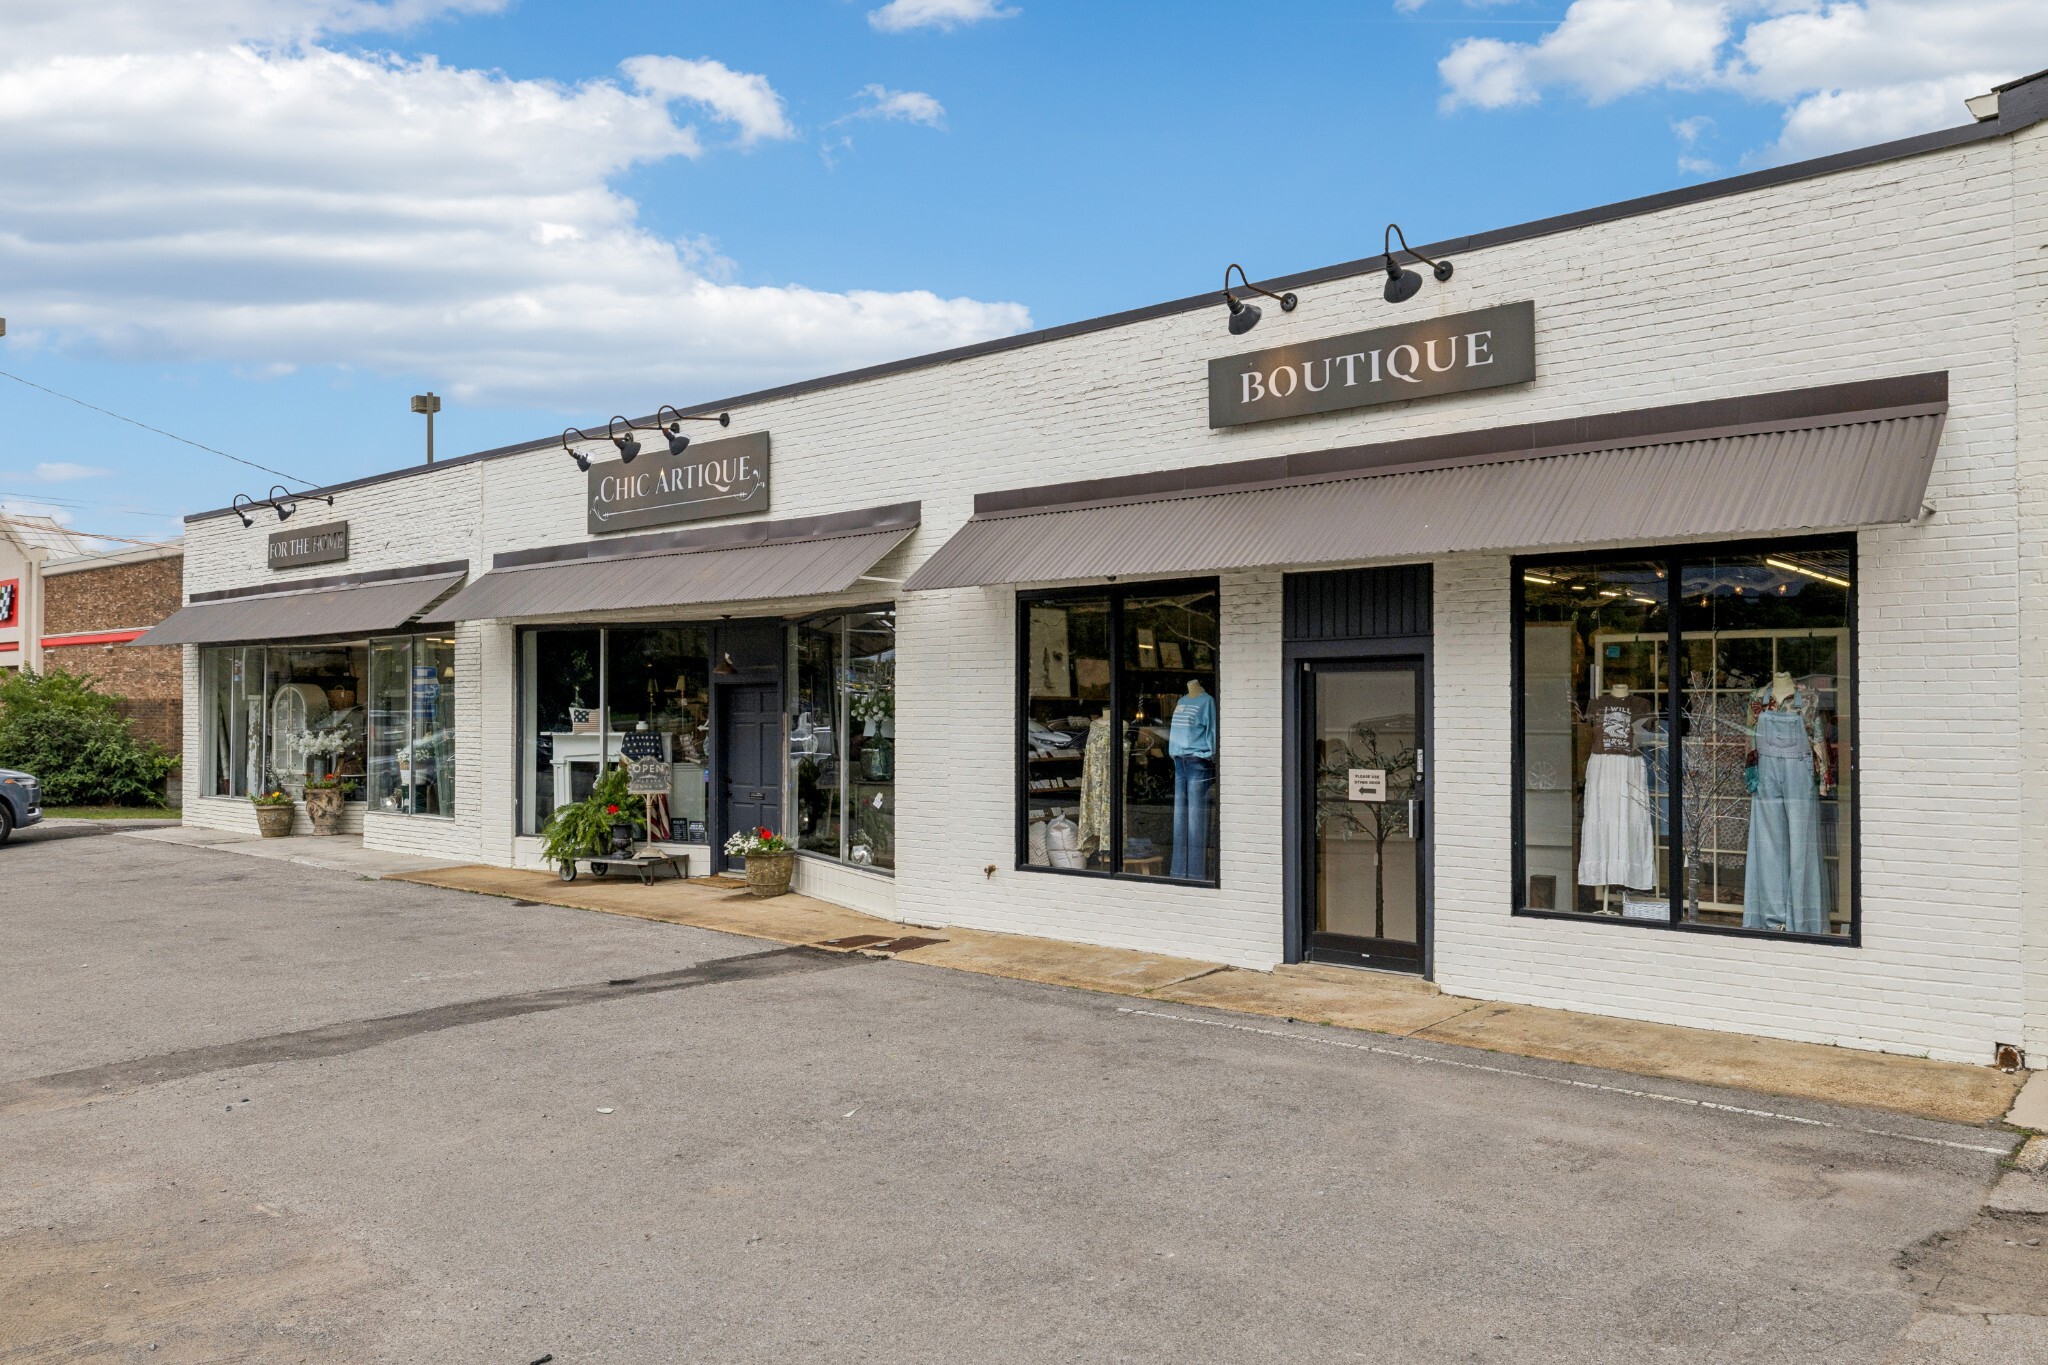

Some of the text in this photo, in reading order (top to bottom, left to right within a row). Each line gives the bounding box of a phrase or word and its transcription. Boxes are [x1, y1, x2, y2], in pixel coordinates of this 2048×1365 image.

[1239, 330, 1494, 404] BOUTIQUE
[601, 456, 750, 502] CHIC ARTIQUE
[269, 531, 344, 559] FOR THE HOME
[1610, 706, 1632, 715] WILL
[632, 764, 664, 773] OPEN
